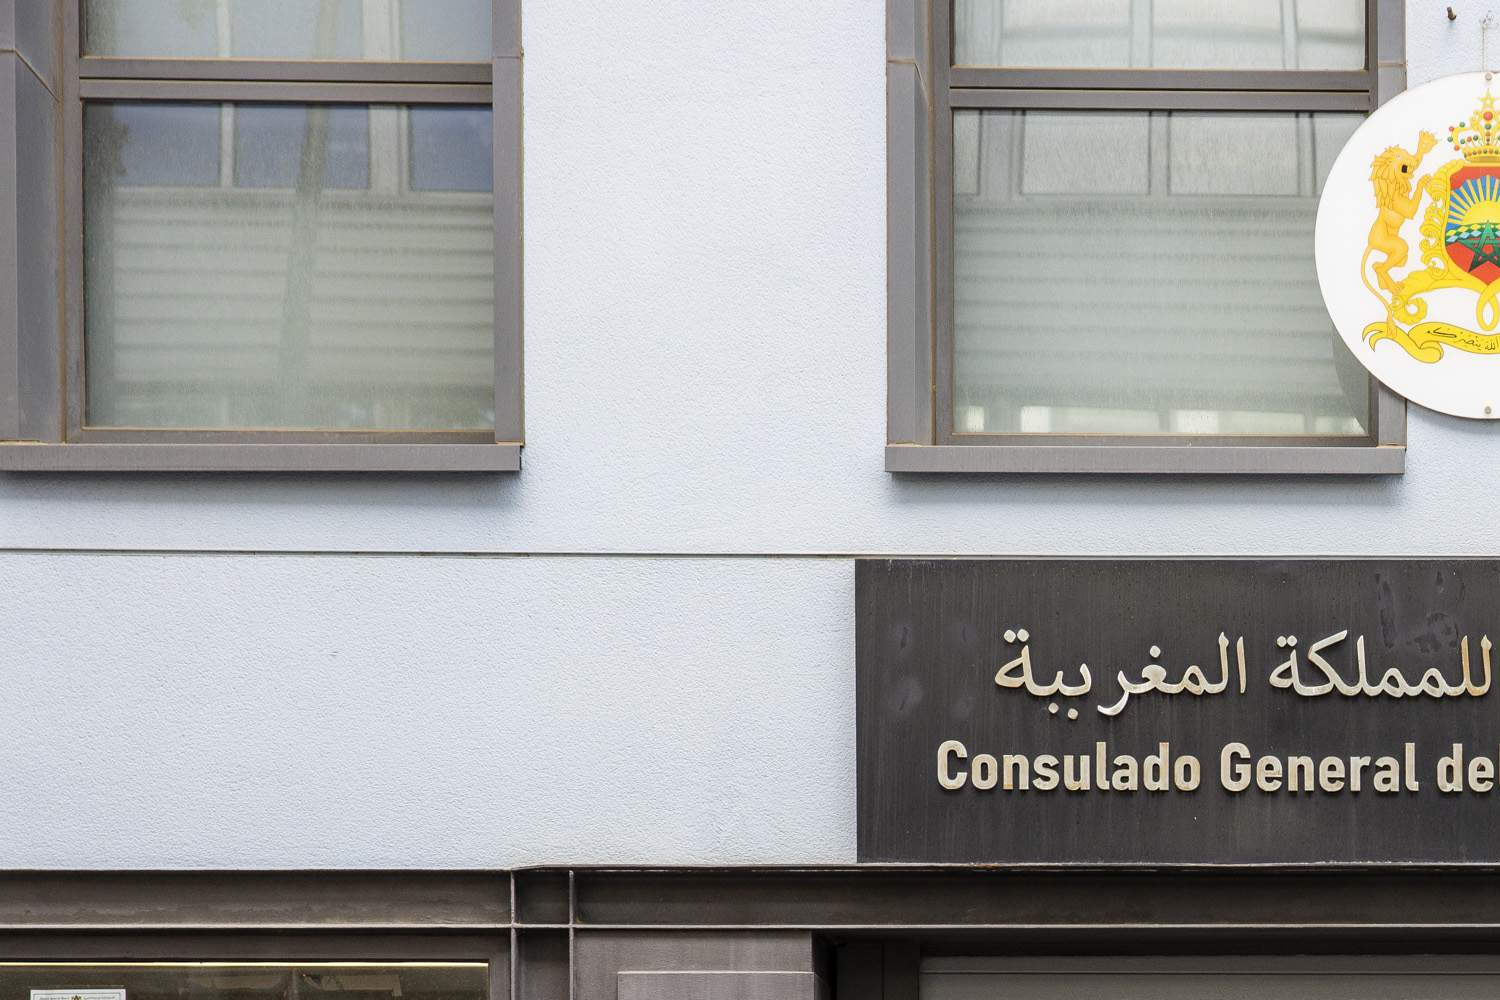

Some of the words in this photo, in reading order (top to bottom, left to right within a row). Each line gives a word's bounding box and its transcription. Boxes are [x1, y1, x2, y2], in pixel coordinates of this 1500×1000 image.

[995, 630, 1246, 719] المغربية
[1269, 630, 1492, 698] للمملكة
[938, 741, 1200, 790] Consulado
[1221, 743, 1419, 792] General
